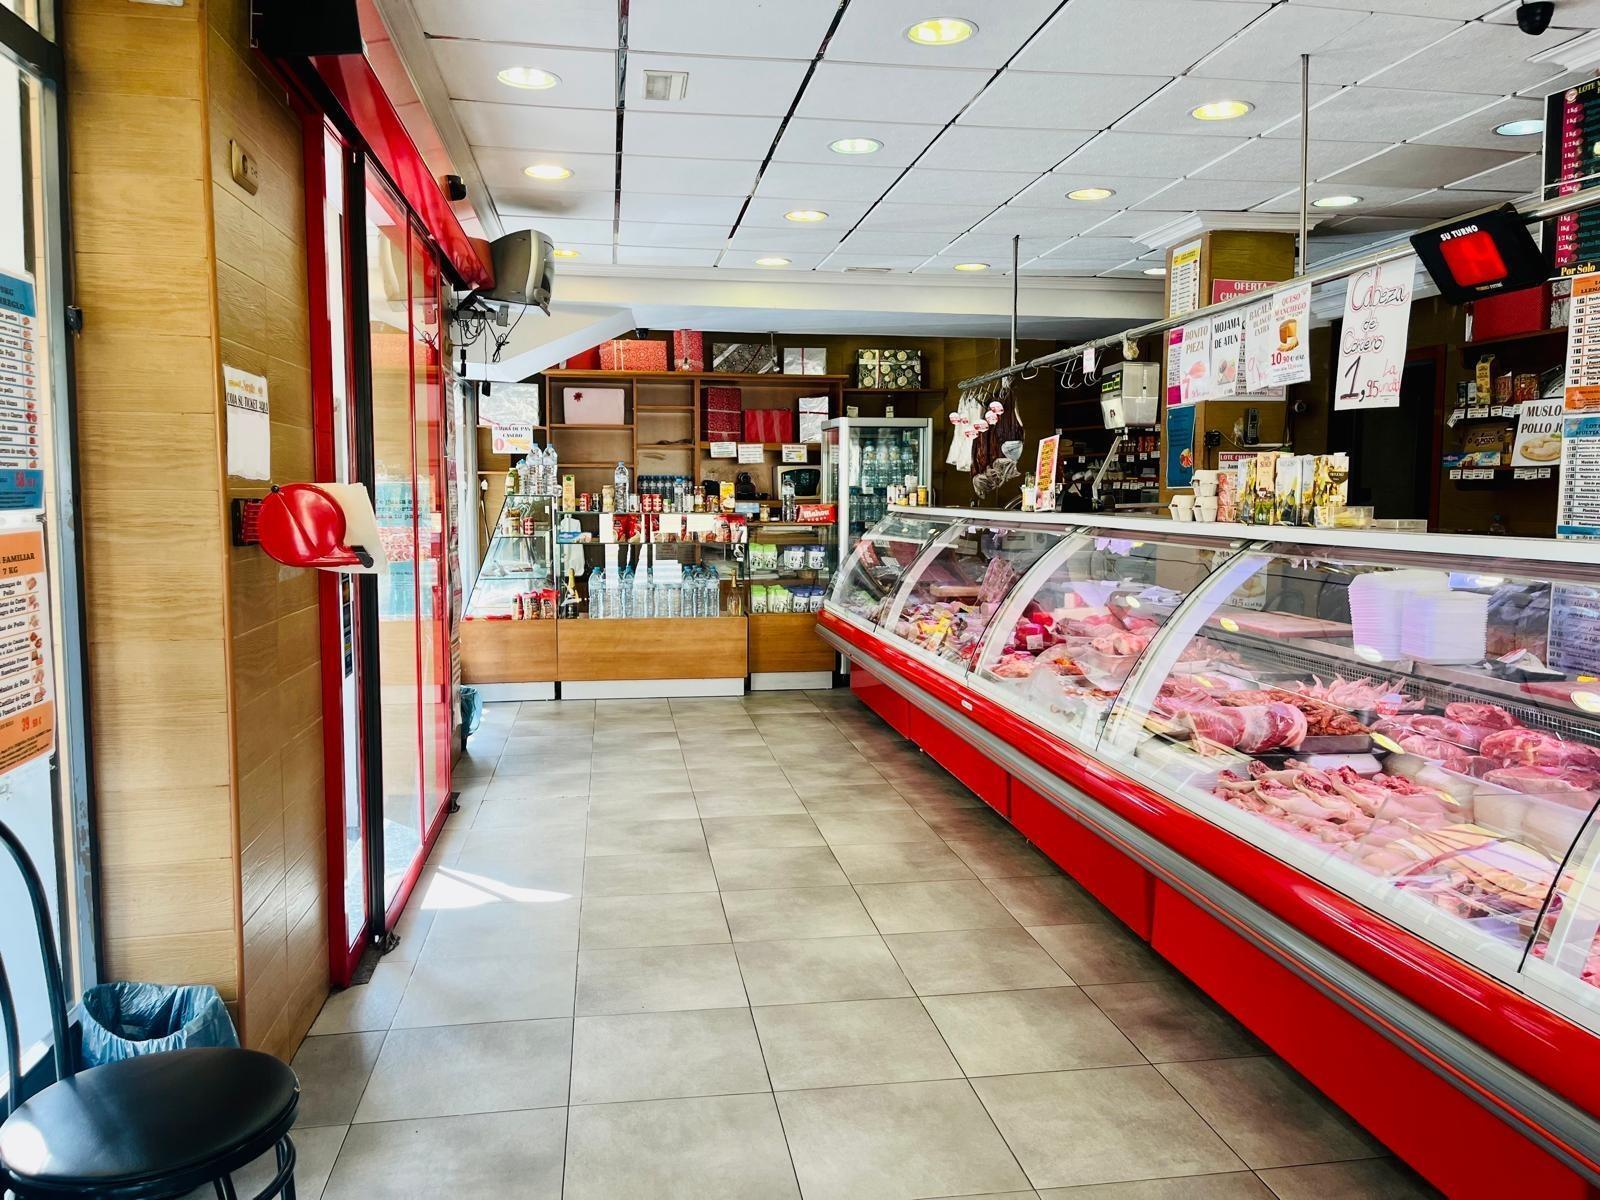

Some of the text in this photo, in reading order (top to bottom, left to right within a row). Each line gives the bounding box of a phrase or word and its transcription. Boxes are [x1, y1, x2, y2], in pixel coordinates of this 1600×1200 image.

[1440, 224, 1479, 241] SU TURNO
[1560, 262, 1597, 277] Por Solo
[1234, 281, 1268, 291] OFERTA
[1281, 293, 1301, 306] QUESO
[1274, 302, 1307, 317] MANCHEGO
[1185, 325, 1209, 340] BONITO
[1214, 317, 1241, 334] MOJAMA
[1186, 340, 1204, 354] PIEZA
[1214, 338, 1222, 349] DE
[244, 396, 258, 410] TICKET
[1526, 404, 1562, 418] MUSLO
[1521, 422, 1551, 435] POLLO
[803, 509, 830, 519] Mahou
[2, 552, 35, 564] FAMILIAR
[9, 566, 18, 574] KG
